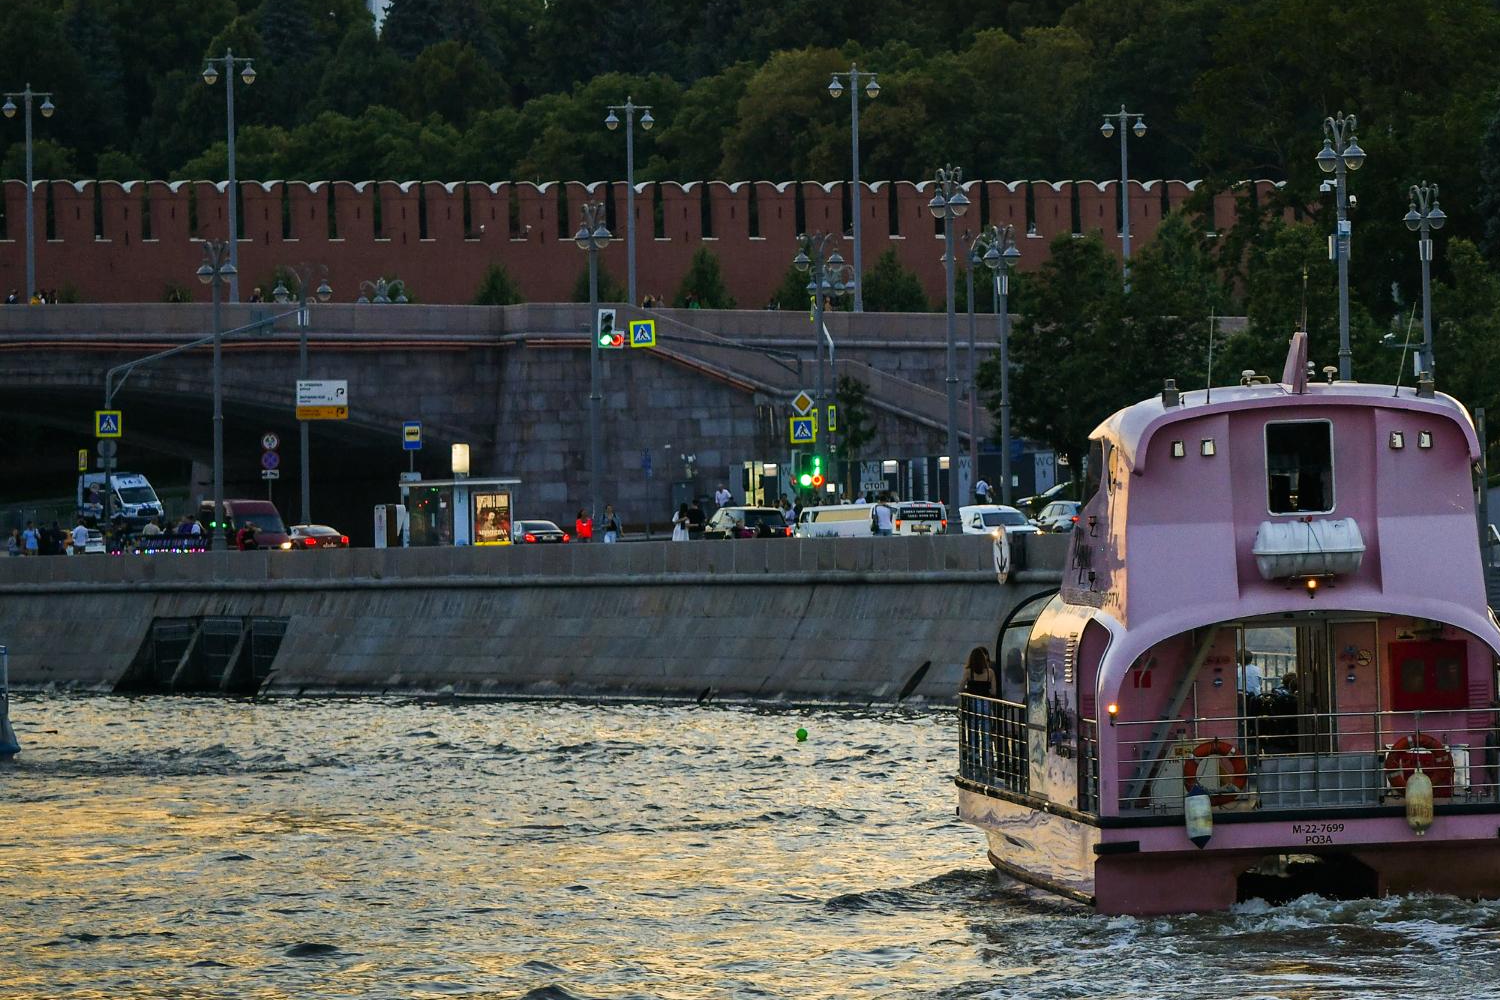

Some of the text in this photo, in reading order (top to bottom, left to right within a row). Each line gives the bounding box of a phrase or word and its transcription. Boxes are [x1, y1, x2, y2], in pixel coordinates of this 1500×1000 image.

[1035, 455, 1053, 466] WC
[1292, 823, 1345, 834] М-22-7699
[1305, 835, 1333, 845] РОЗА
